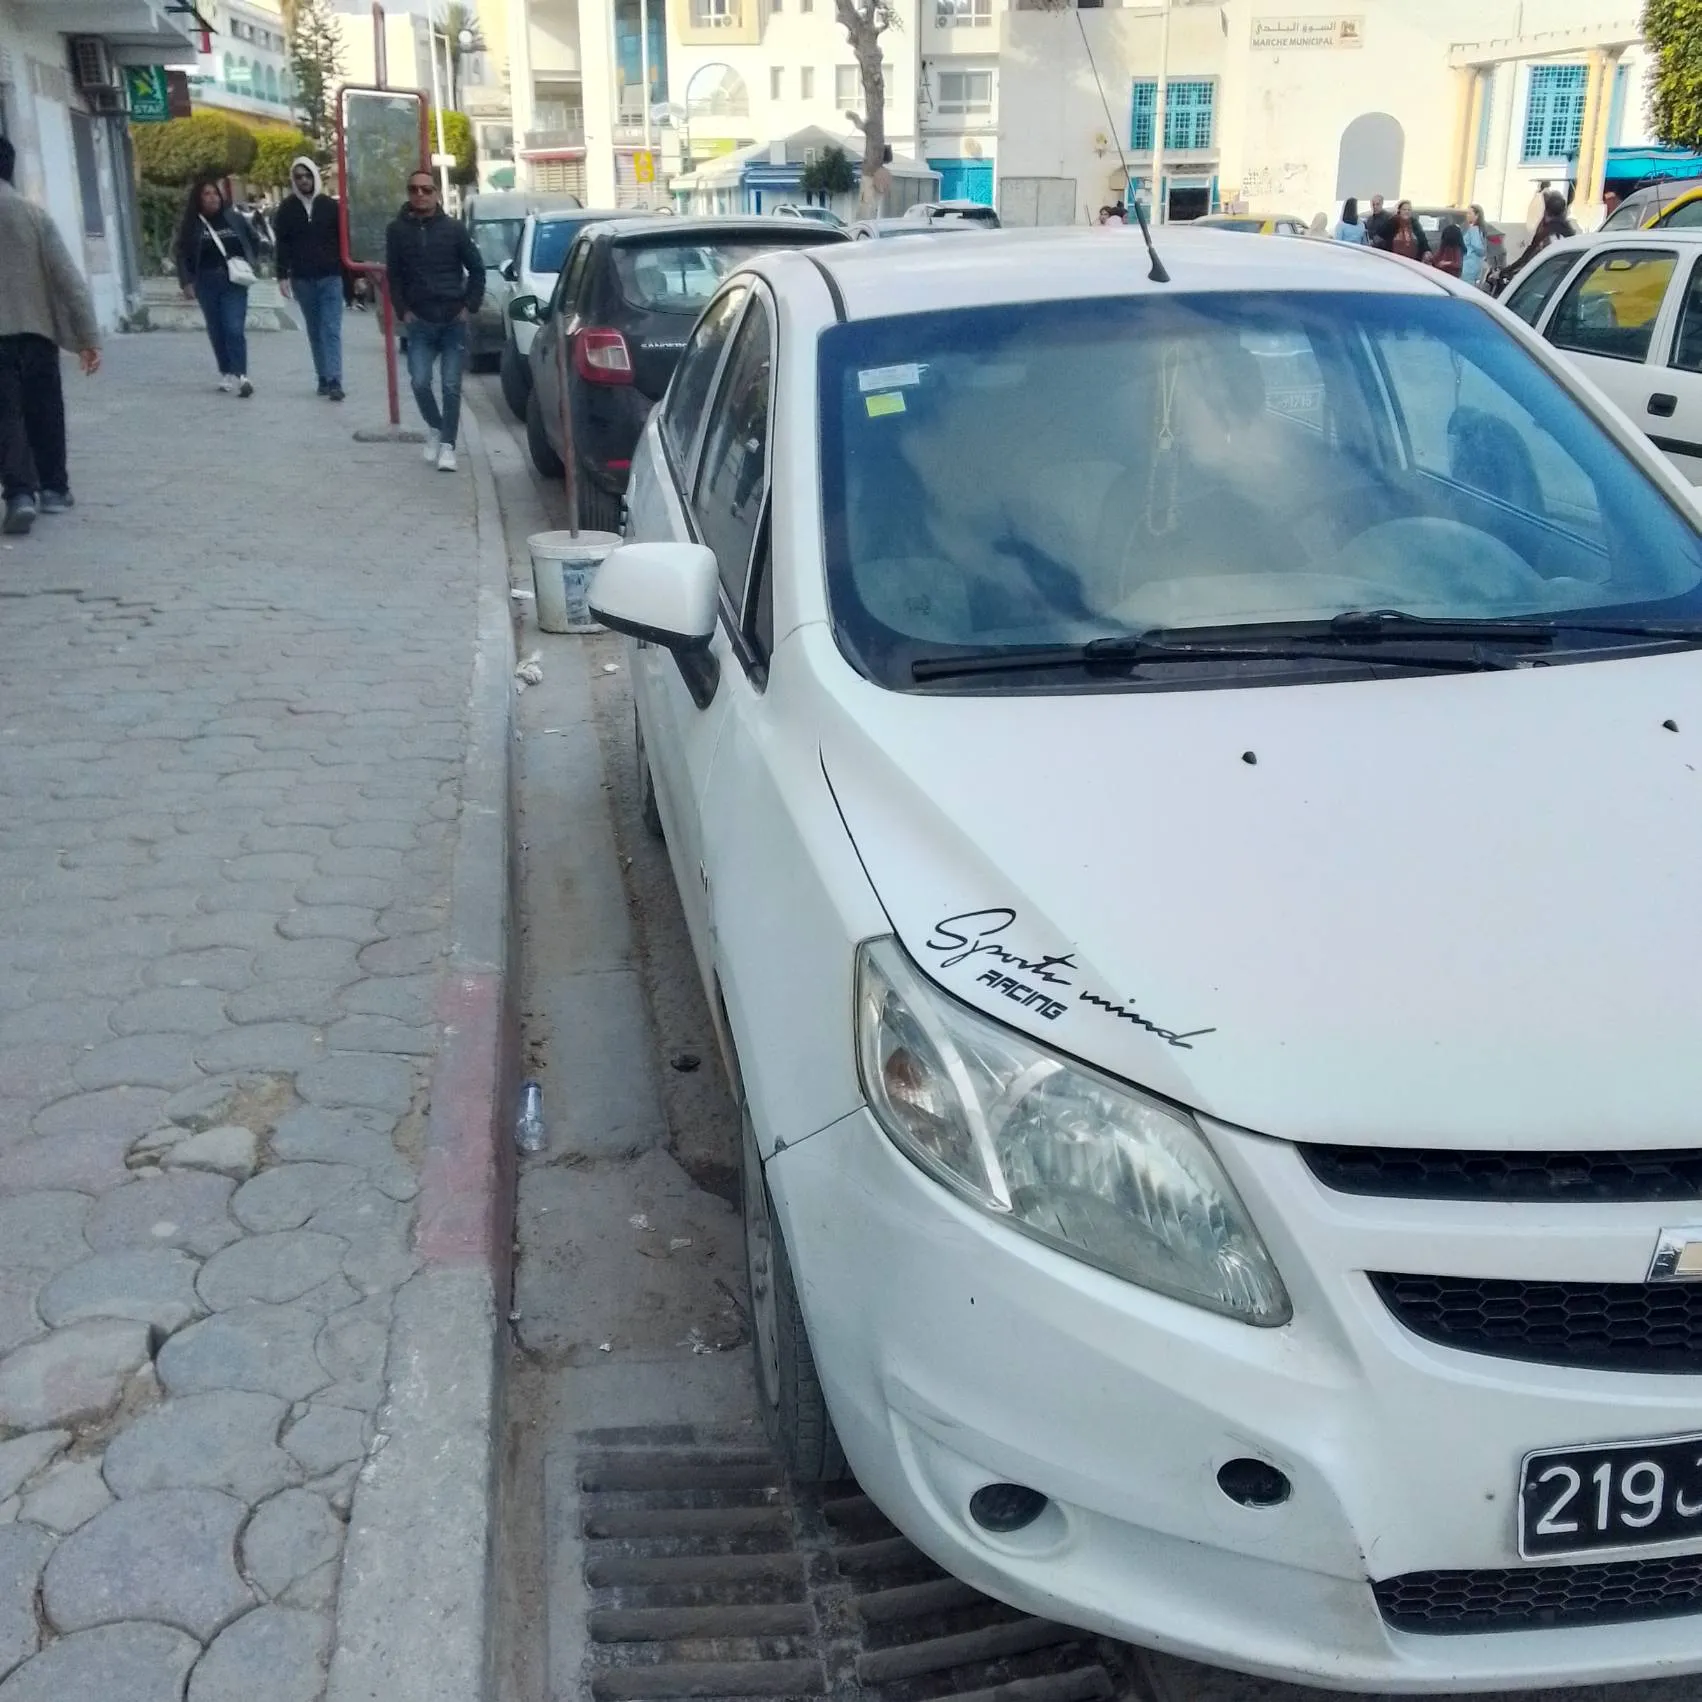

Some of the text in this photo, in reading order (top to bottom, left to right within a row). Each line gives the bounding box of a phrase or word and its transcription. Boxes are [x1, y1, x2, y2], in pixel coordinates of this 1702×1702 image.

[1252, 36, 1334, 47] MARCHE MUNICIPAL
[1256, 20, 1336, 35] السوق البلدي
[976, 969, 1068, 1020] RACING
[1080, 990, 1217, 1050] mind
[1536, 1461, 1665, 1535] 219
